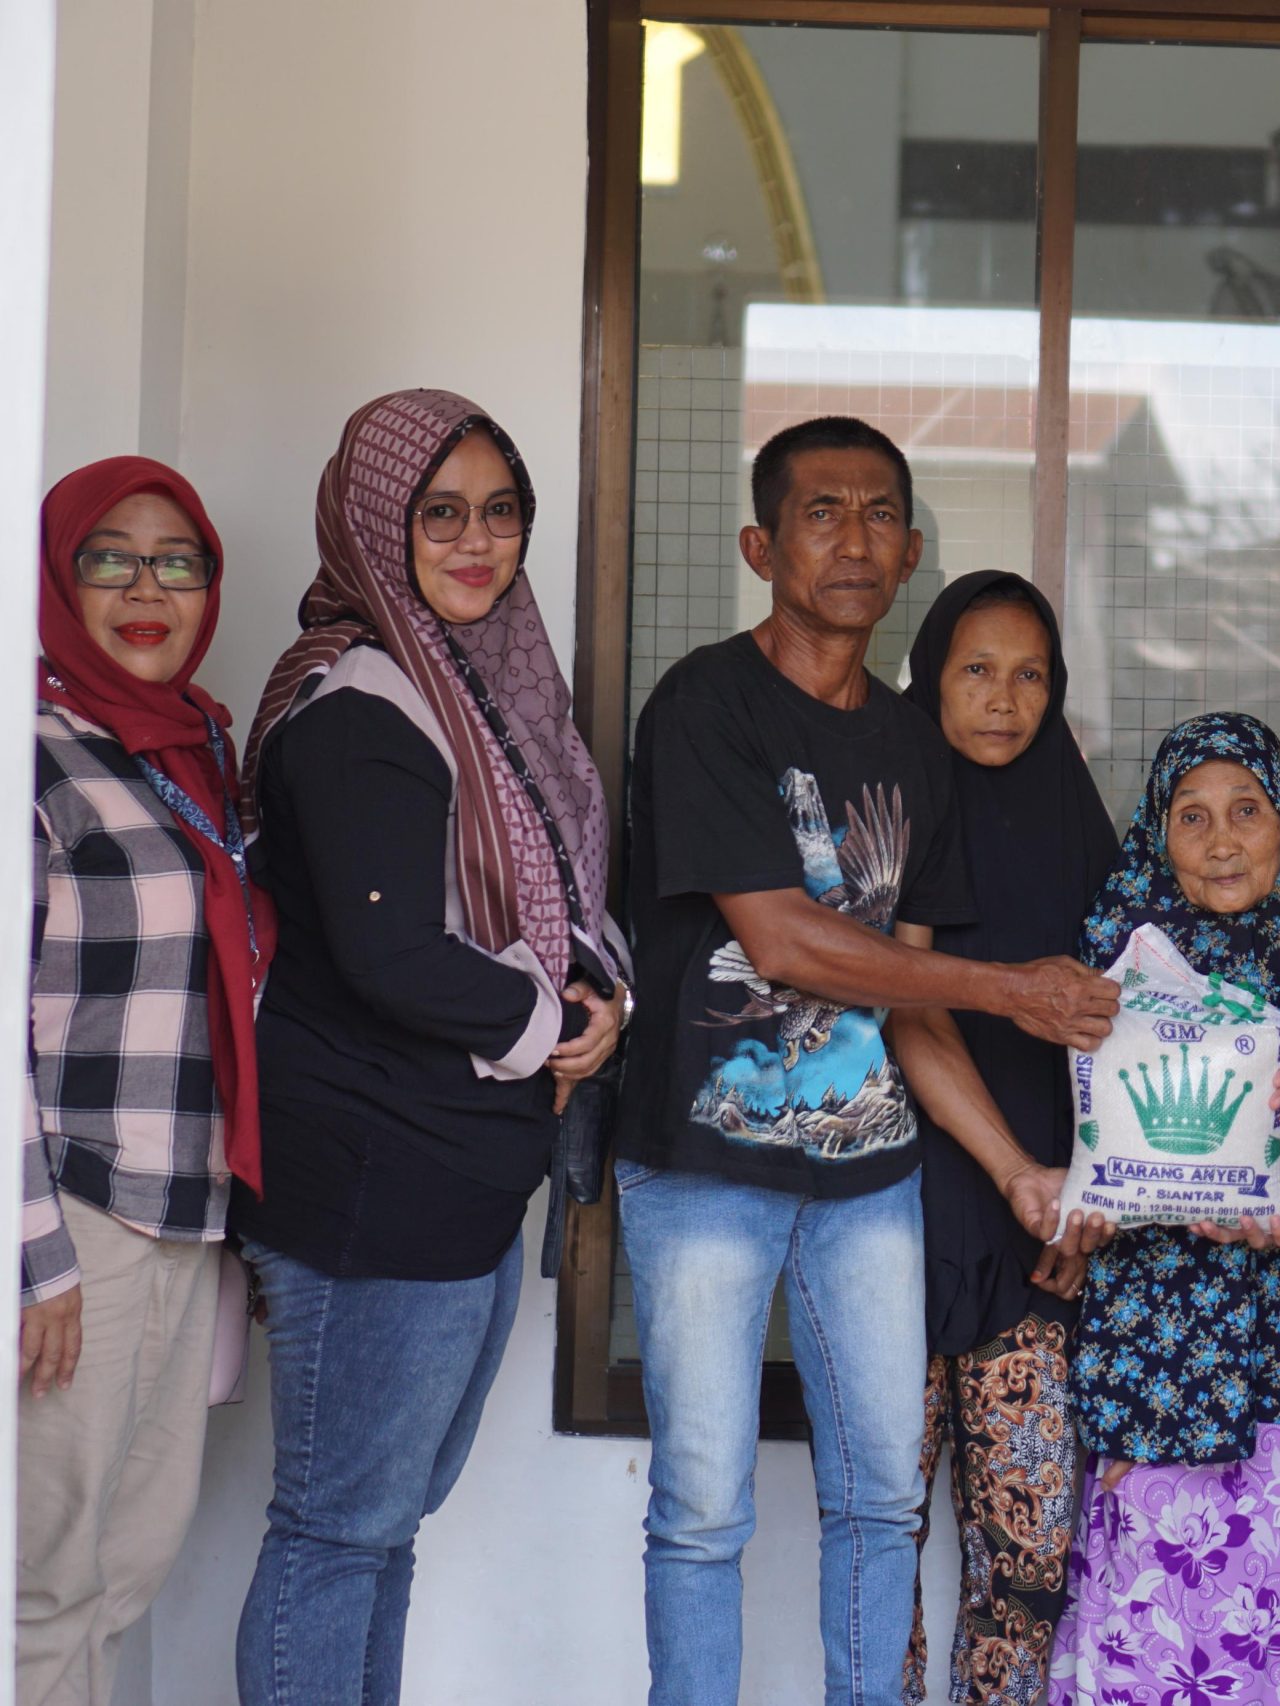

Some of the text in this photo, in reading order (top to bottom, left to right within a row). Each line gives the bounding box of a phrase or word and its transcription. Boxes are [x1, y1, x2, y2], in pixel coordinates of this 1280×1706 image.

[1160, 1022, 1197, 1040] GM
[1076, 1054, 1094, 1114] SUPER
[1112, 1160, 1248, 1183] KARANG ANYER
[1081, 1190, 1115, 1210] KEMTAN
[1117, 1199, 1126, 1211] RI
[1128, 1203, 1141, 1212] PD
[1137, 1186, 1225, 1202] P. SIANTAR
[1121, 1213, 1186, 1223] BRUTTO
